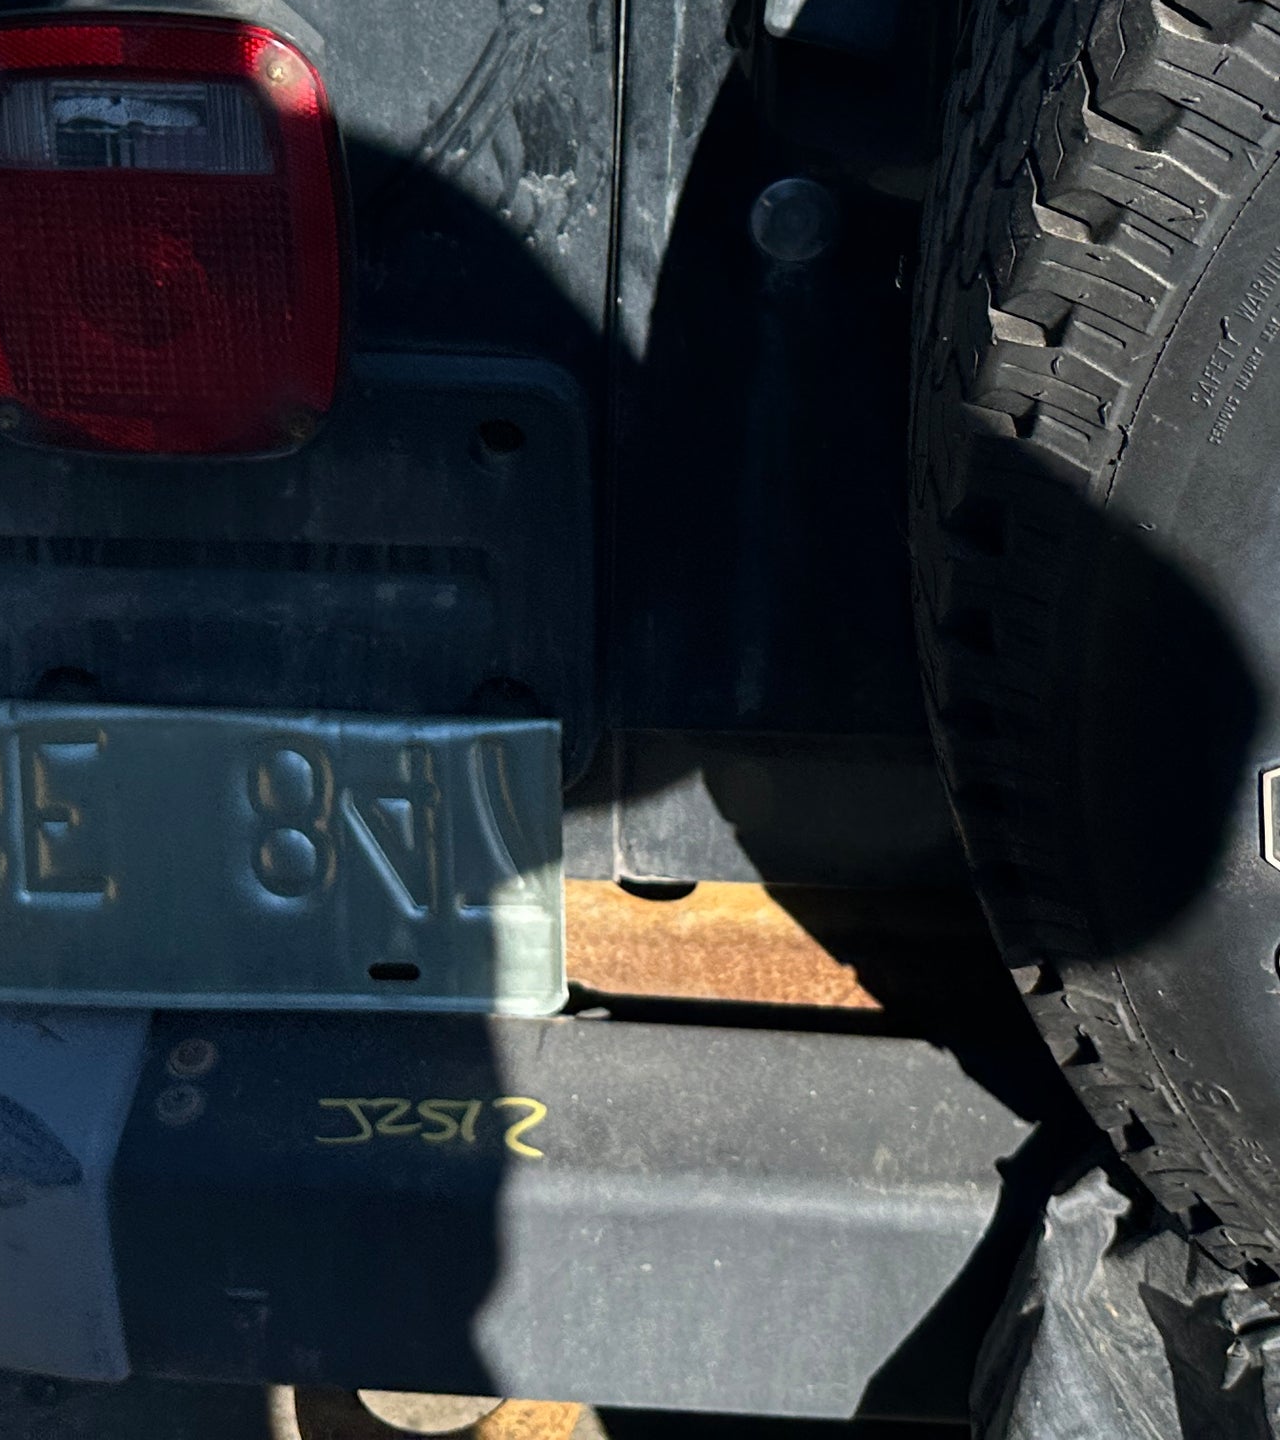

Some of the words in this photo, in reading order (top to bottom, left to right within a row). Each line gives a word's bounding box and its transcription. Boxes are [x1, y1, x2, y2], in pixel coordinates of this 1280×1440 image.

[1190, 332, 1241, 410] SAFETY
[1207, 394, 1240, 447] SERIOUS
[1235, 346, 1265, 392] INJURY
